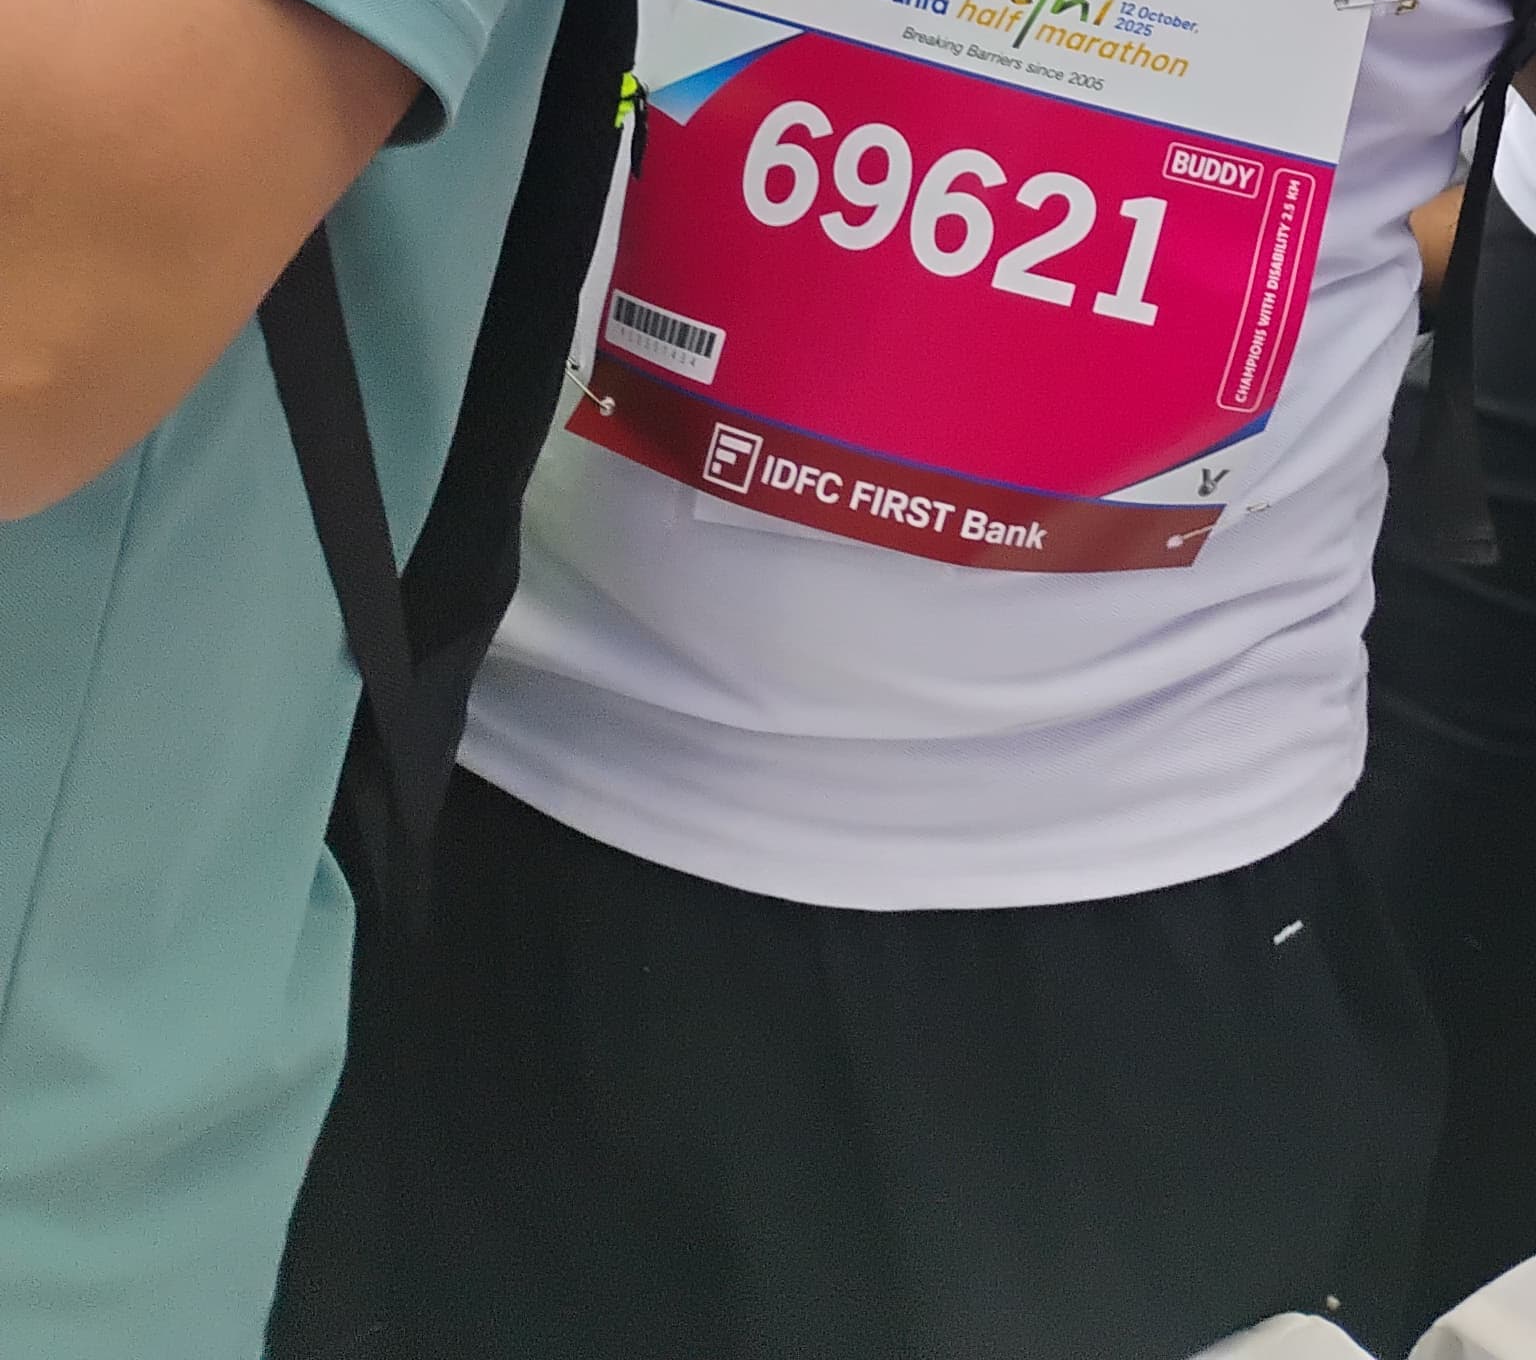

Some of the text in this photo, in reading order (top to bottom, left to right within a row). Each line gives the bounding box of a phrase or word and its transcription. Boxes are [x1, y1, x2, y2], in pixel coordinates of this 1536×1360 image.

[1119, 0, 1135, 16] 12
[901, 24, 1105, 92] Breaking Barriers since 2005
[1034, 22, 1190, 79] marathon
[1113, 16, 1154, 39] 2025
[1170, 150, 1256, 193] BUDDY
[741, 99, 1170, 327] 69621
[1234, 179, 1302, 404] CHAMPIONS WITH DISABILITY 2.5 KM
[760, 454, 1048, 551] IDFC FIRST Bank
